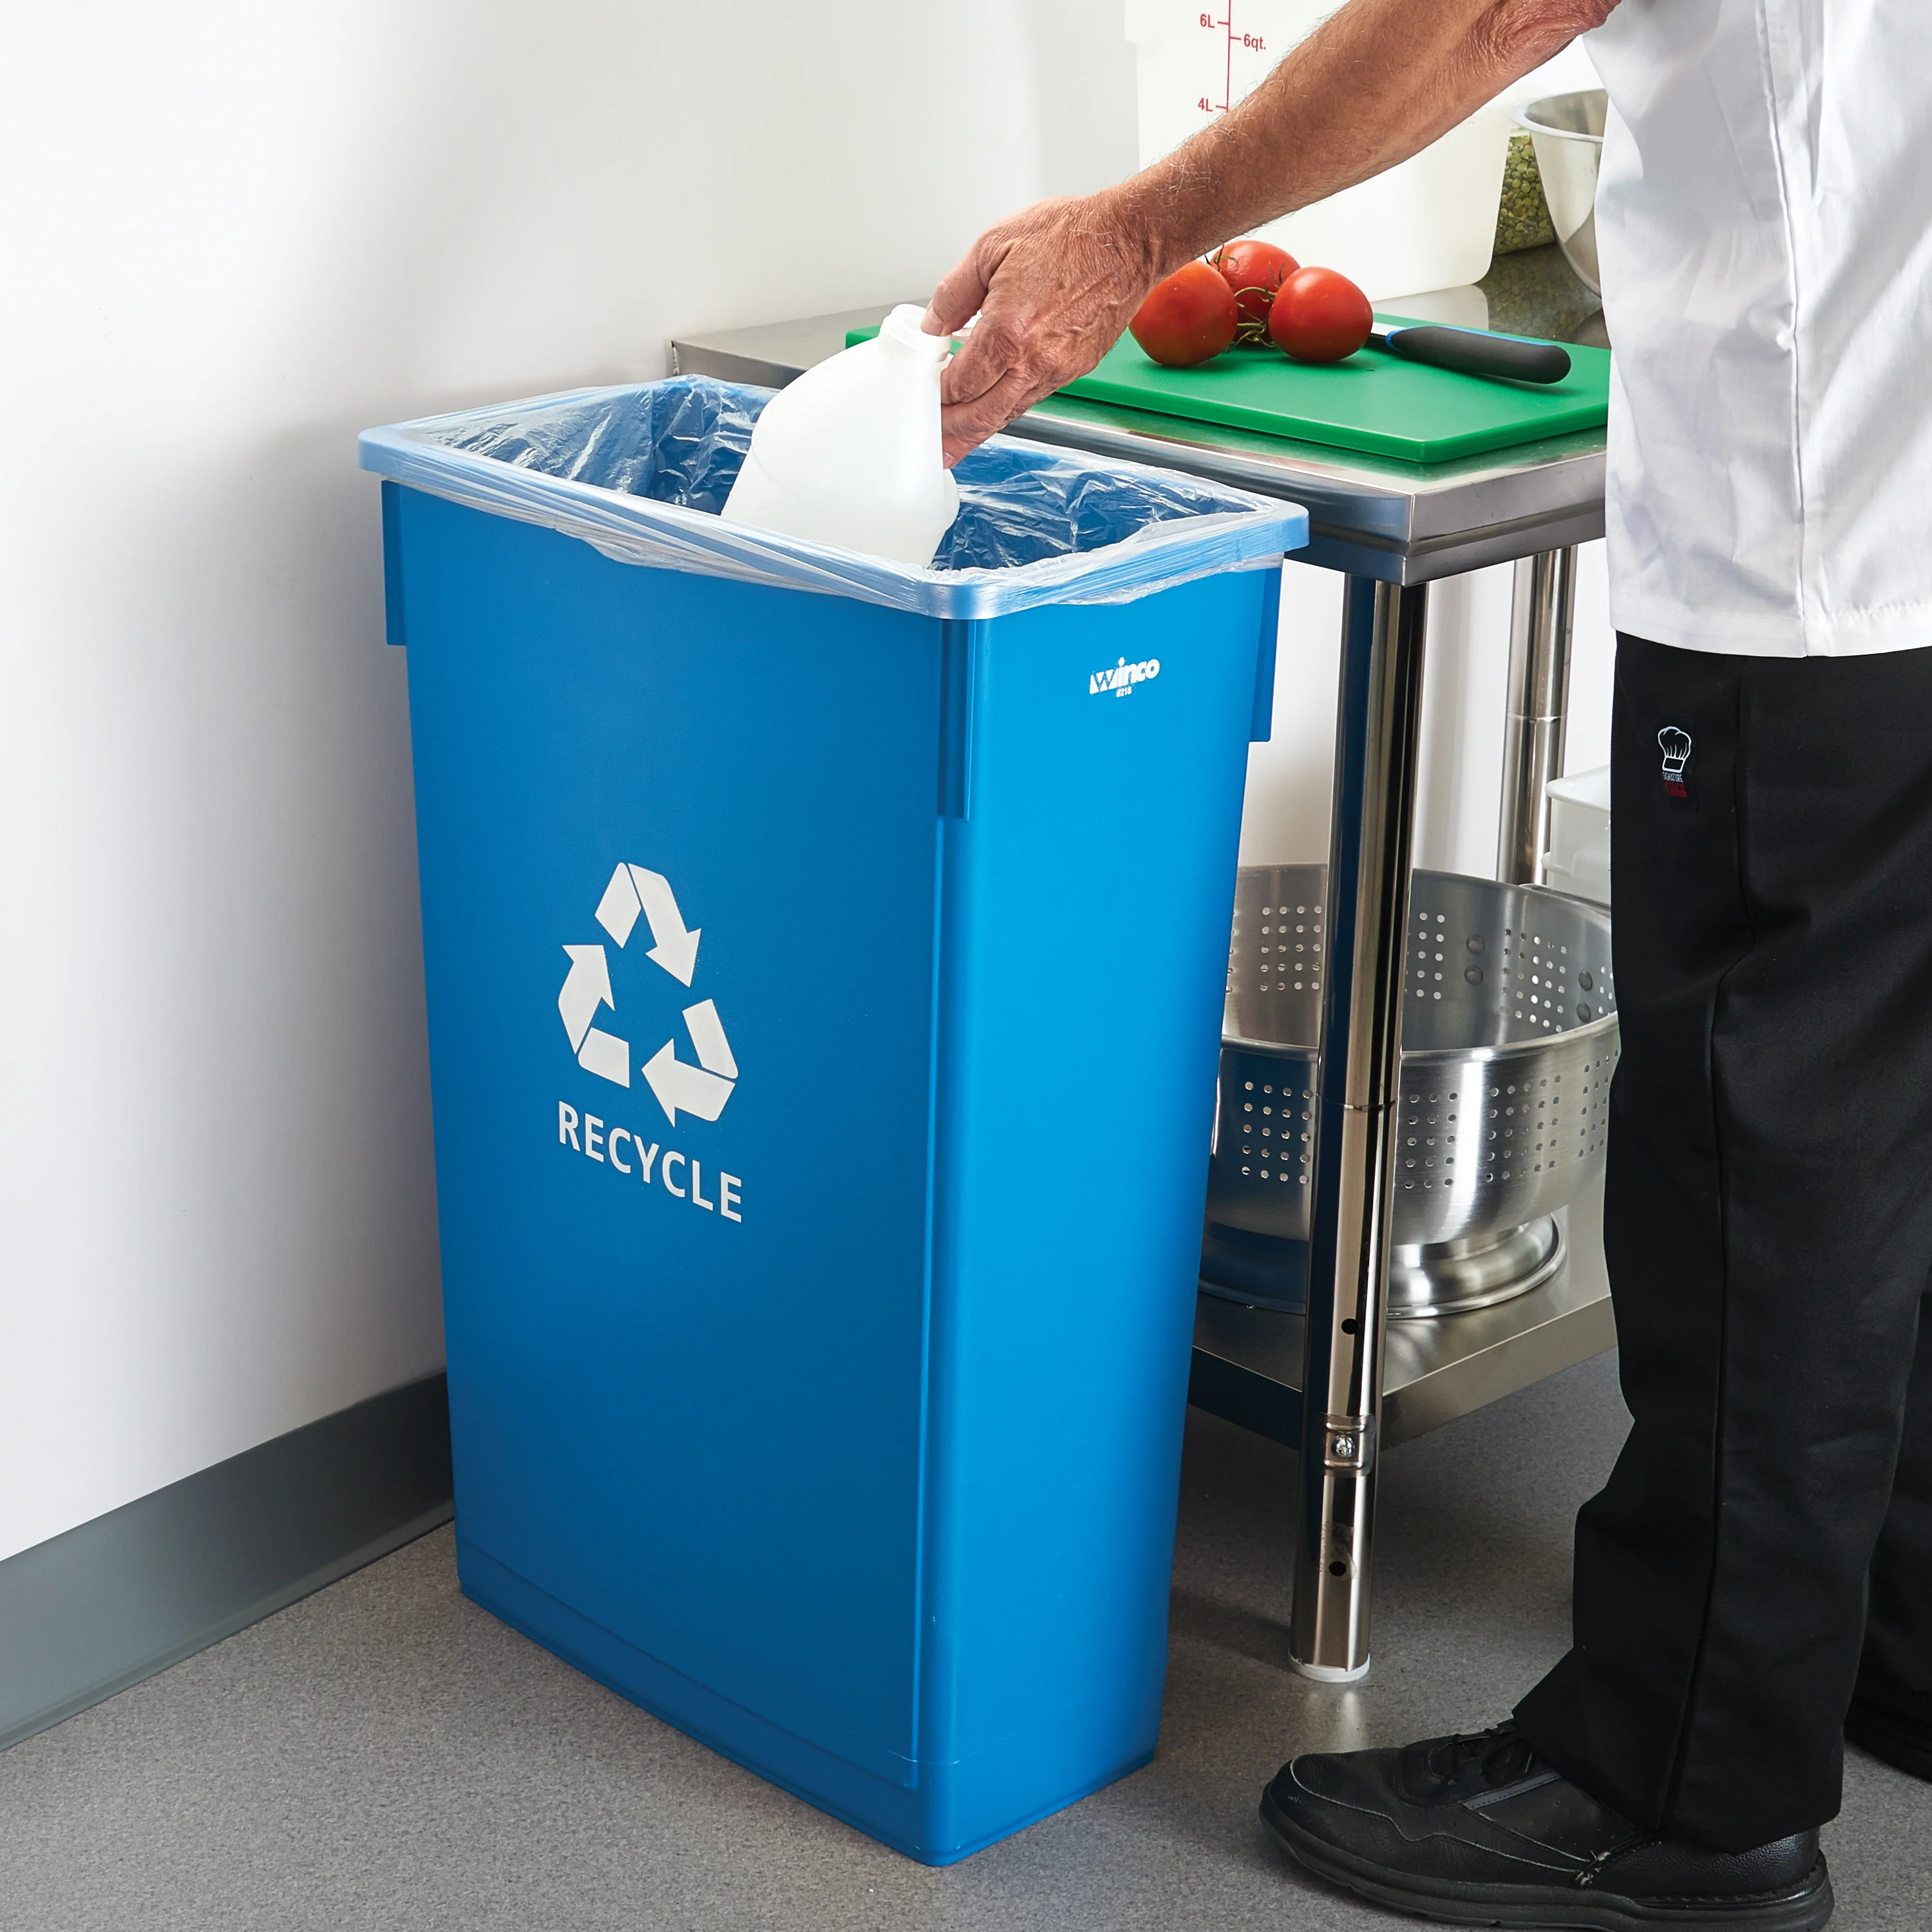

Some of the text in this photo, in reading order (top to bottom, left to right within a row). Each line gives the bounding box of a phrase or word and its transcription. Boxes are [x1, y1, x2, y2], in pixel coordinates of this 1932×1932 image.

[1200, 14, 1215, 28] 6L
[1244, 33, 1266, 52] 6qt.
[1198, 97, 1213, 112] 4L
[558, 1100, 742, 1223] RECYCLE
